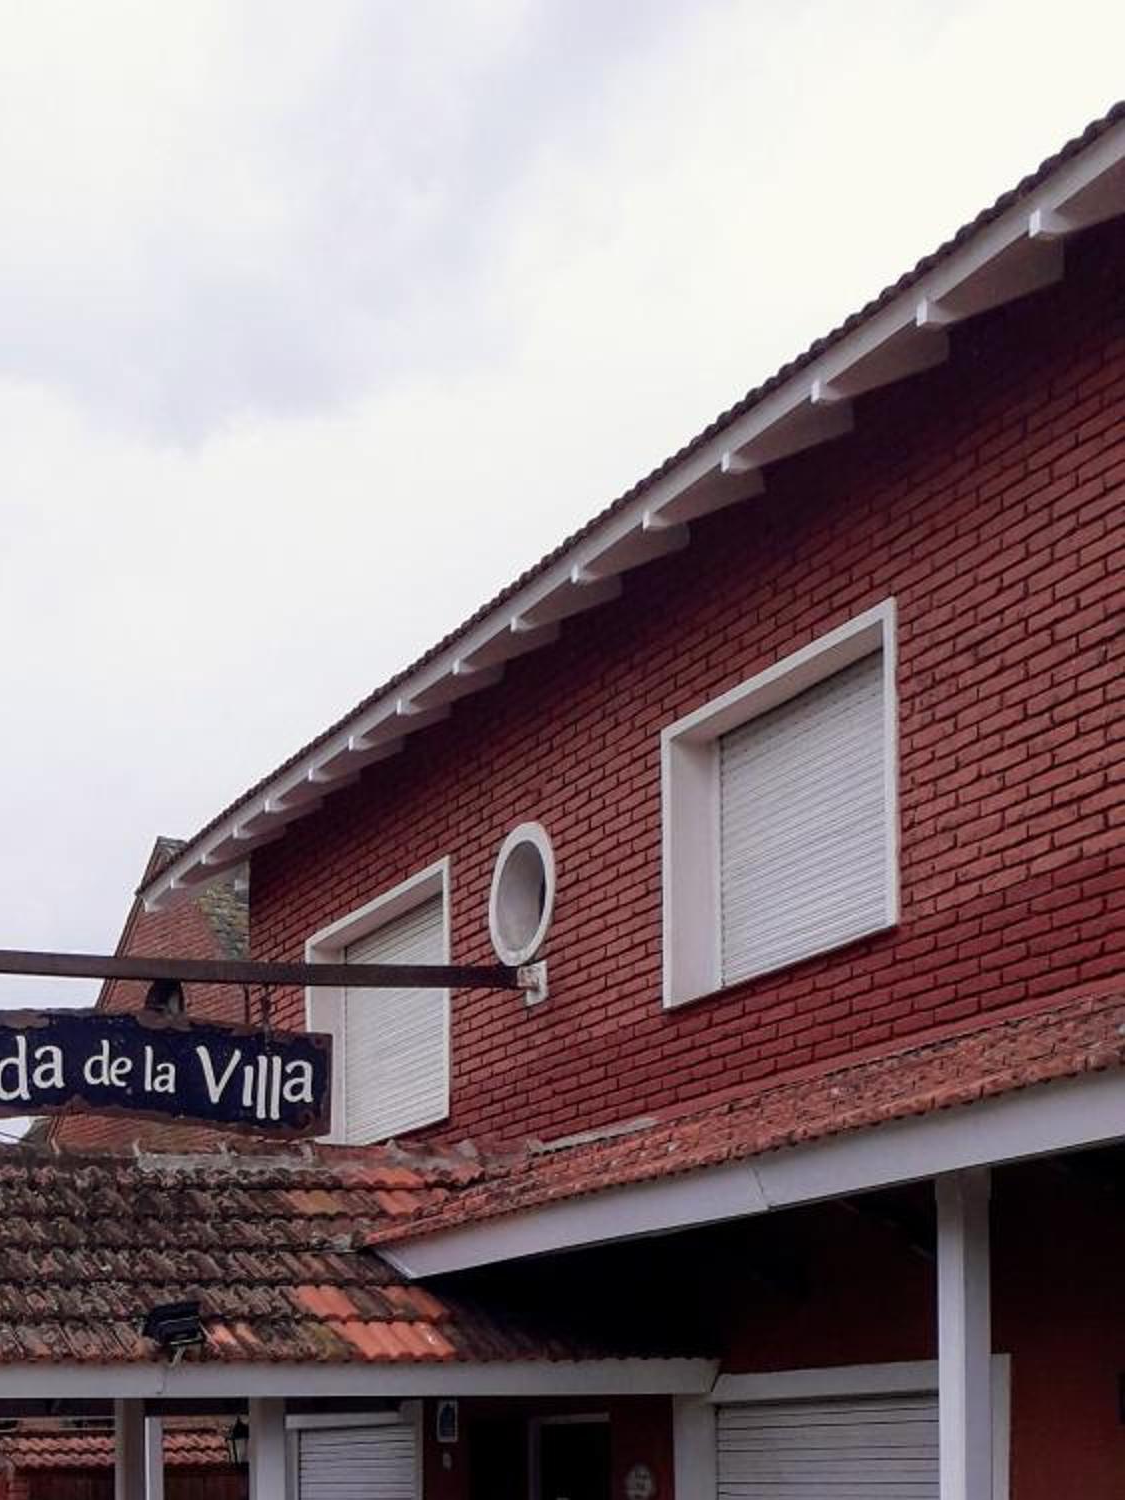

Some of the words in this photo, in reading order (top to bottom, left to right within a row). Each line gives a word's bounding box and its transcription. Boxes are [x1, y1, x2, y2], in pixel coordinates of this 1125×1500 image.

[82, 1038, 133, 1087] de
[144, 1045, 176, 1094] la
[195, 1045, 314, 1120] Villa
